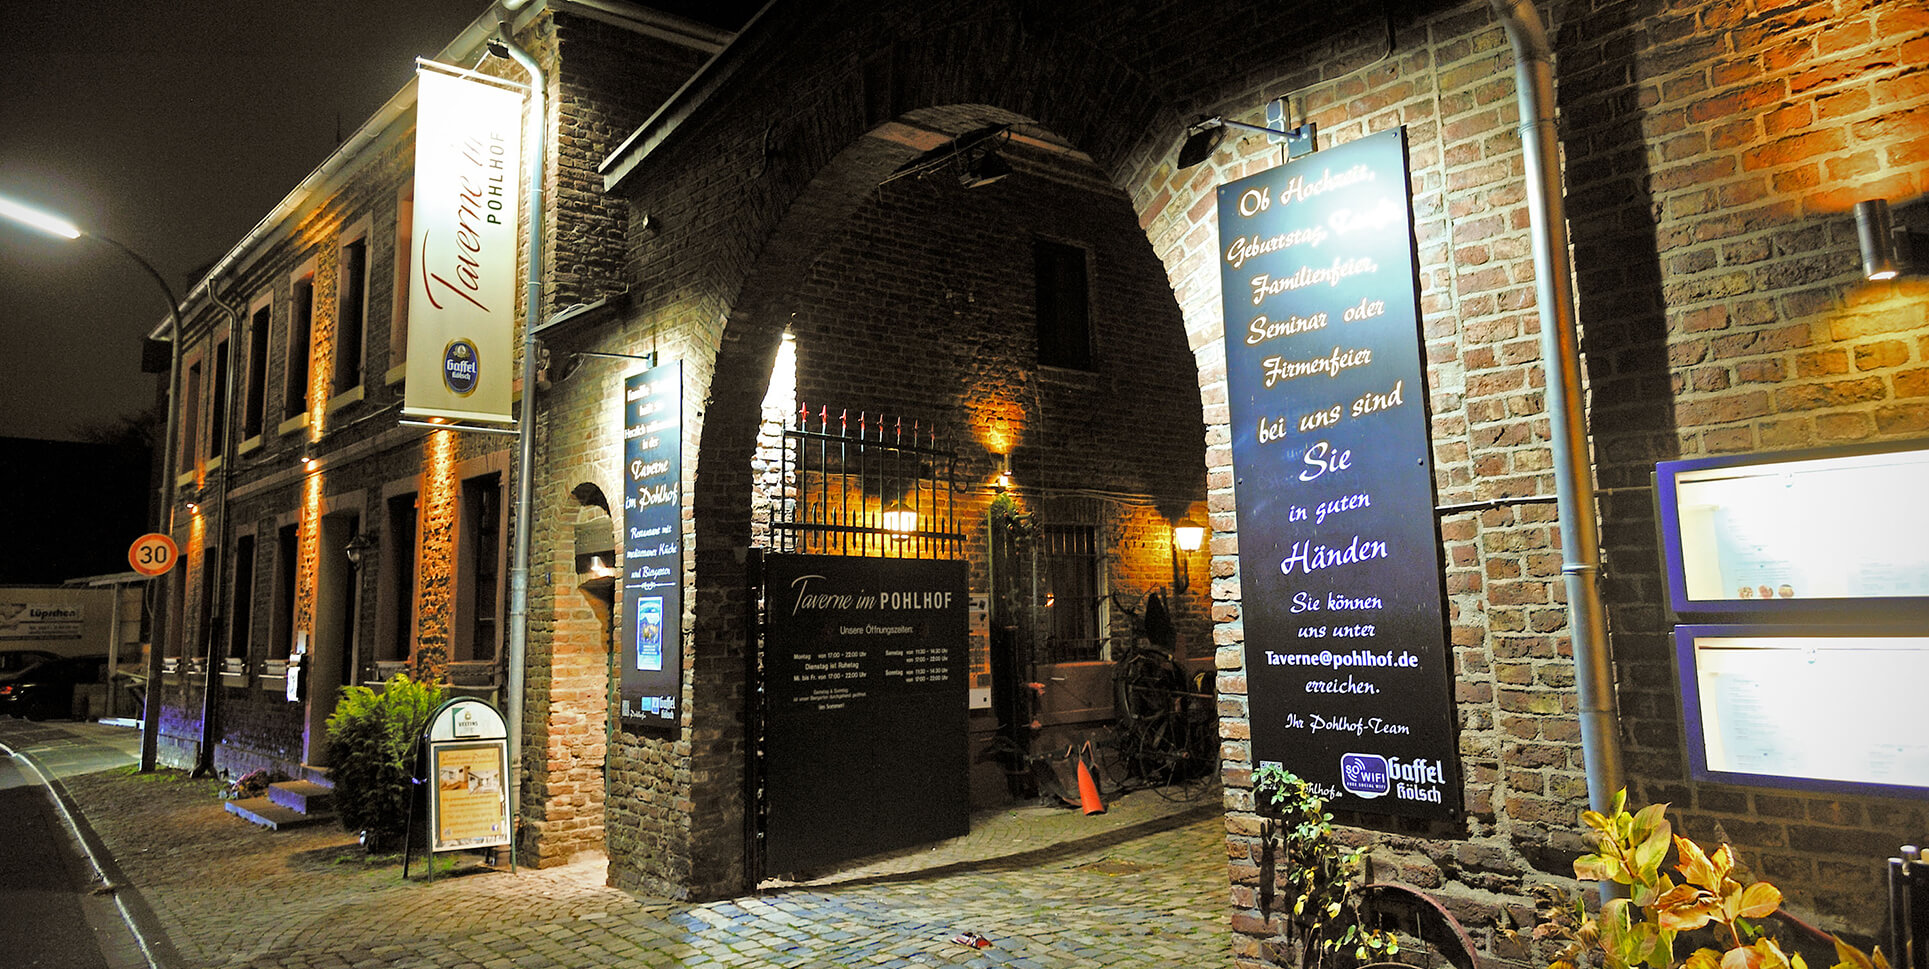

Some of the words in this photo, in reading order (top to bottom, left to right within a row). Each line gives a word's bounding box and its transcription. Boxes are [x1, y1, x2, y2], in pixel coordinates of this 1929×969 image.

[486, 131, 505, 225] POHLHOF
[1239, 186, 1270, 216] Ob
[1226, 224, 1328, 269] Geburtstag,
[1250, 256, 1379, 306] Familienfeier,
[1246, 311, 1328, 345] Seminar
[1343, 297, 1386, 324] oder
[447, 359, 477, 374] Gaffel
[1263, 346, 1372, 388] Firmenfeier
[1258, 416, 1287, 445] bei
[1299, 402, 1342, 432] uns
[1351, 380, 1404, 418] sind
[631, 459, 669, 481] Taverne
[1299, 441, 1352, 482] Sie
[625, 495, 637, 510] im
[639, 481, 679, 513] Pohlhof
[1288, 503, 1308, 524] in
[1315, 491, 1371, 525] guten
[140, 546, 167, 564] 30
[1280, 534, 1388, 576] Händen
[791, 575, 853, 616] Taverne
[856, 589, 878, 610] im
[880, 592, 952, 610] POHLHOF
[1290, 591, 1321, 613] Sie
[1327, 591, 1383, 611] können
[840, 625, 864, 635] Unsere
[1298, 625, 1327, 639] uns
[1332, 622, 1376, 638] unter
[805, 663, 829, 671] Dienstag
[838, 662, 859, 670] Ruhetag
[1264, 650, 1419, 669] Taverne@pohlhof.de
[1305, 675, 1381, 694] erreichen.
[1285, 712, 1304, 729] Ihr
[1309, 713, 1410, 736] Pohlhof-Team
[1345, 764, 1360, 775] SO
[1360, 771, 1385, 783] WIFI
[1388, 756, 1446, 785] Gaffel
[1396, 782, 1442, 804] Kölsch
